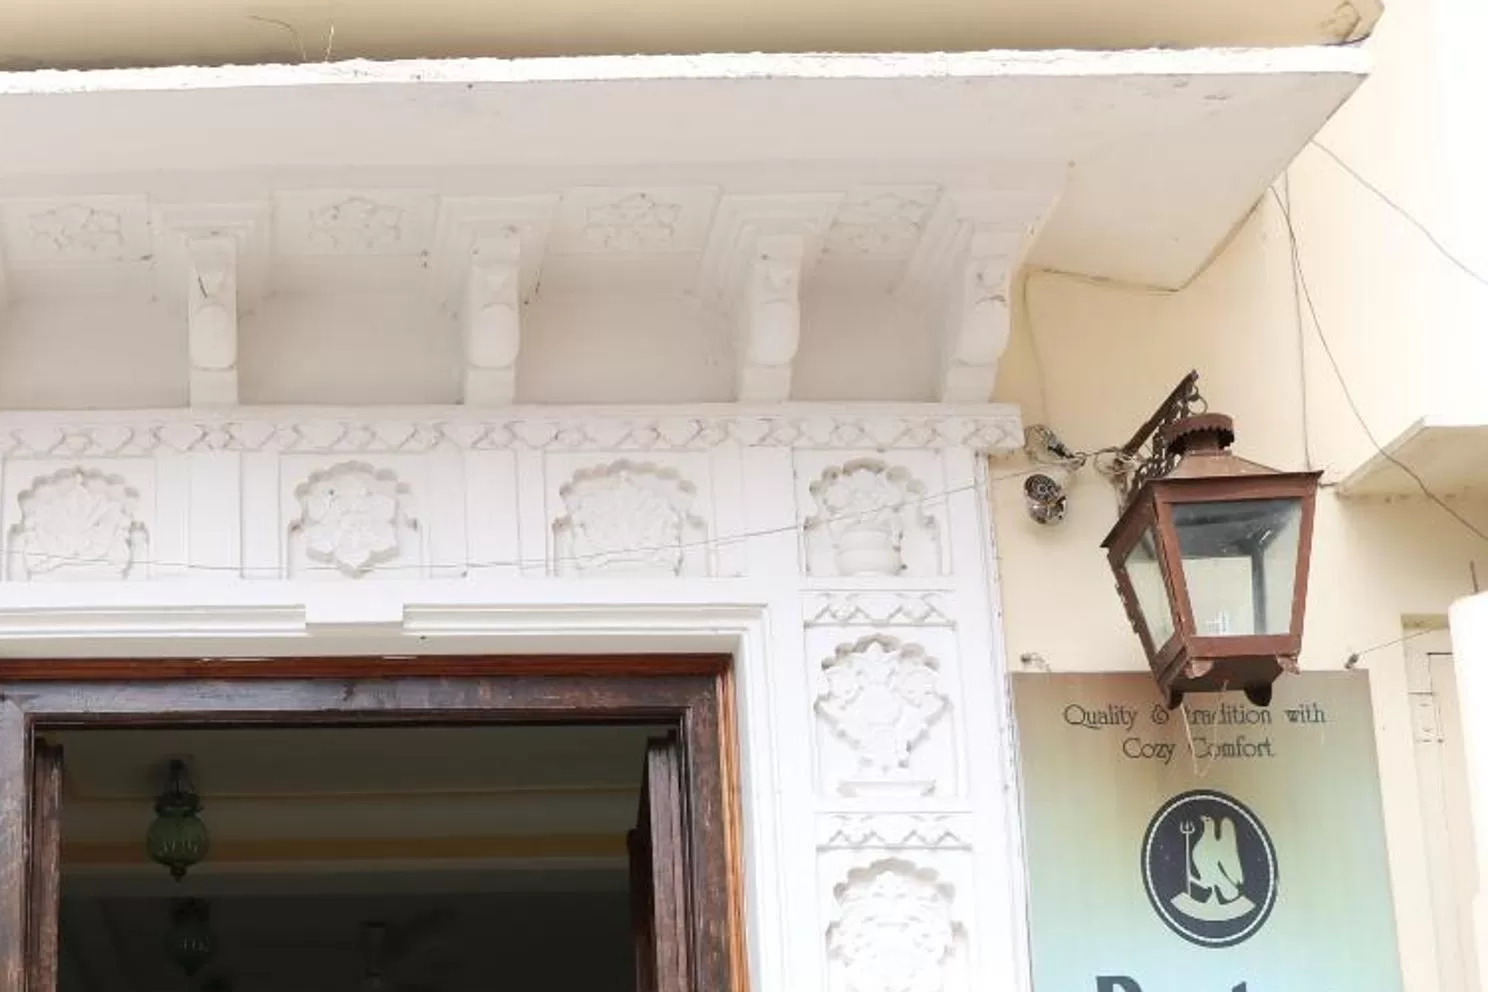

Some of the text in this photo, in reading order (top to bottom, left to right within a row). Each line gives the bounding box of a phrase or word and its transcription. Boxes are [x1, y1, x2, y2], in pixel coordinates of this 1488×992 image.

[1063, 703, 1137, 731] Quality
[1284, 703, 1326, 723] with
[1122, 737, 1176, 765] Cozy
